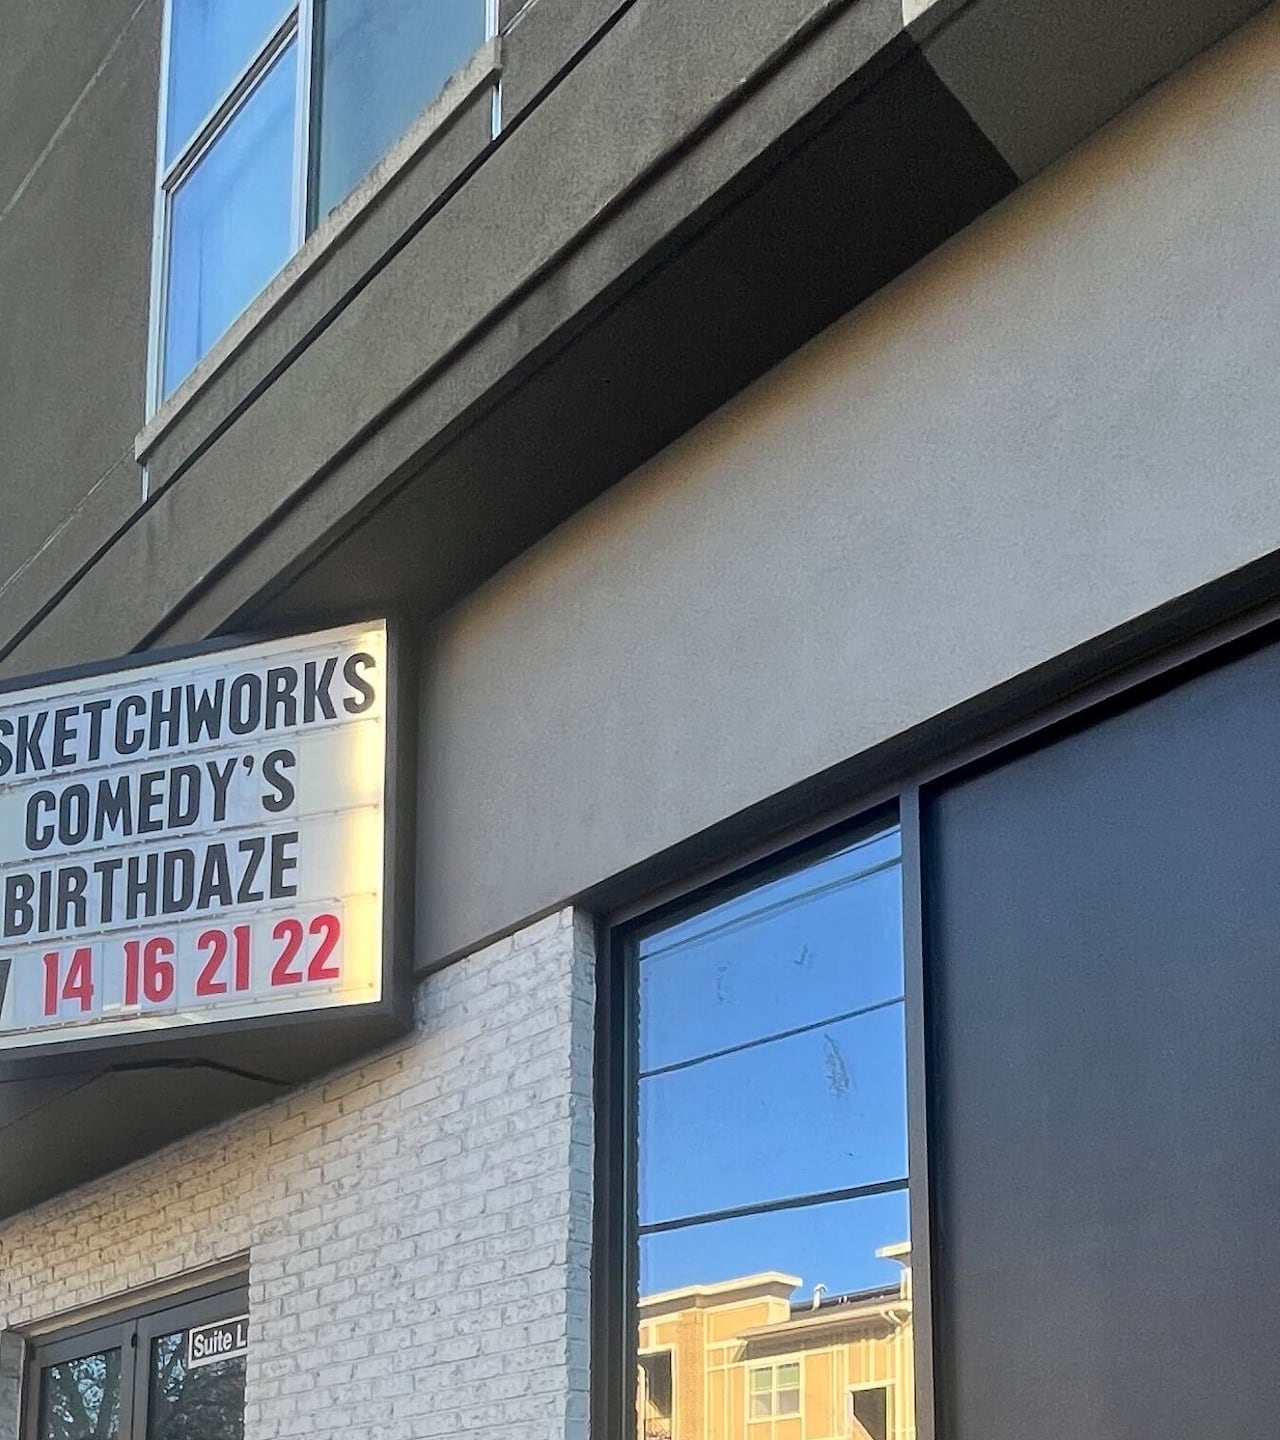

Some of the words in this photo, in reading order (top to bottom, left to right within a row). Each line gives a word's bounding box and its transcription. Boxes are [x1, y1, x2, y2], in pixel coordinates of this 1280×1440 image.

[25, 749, 297, 851] COMEDY'S
[3, 831, 300, 938] BIRTHDAZE
[43, 947, 95, 1017] 14
[123, 936, 175, 1006] 16
[196, 924, 251, 997] 21
[270, 913, 341, 987] 22
[193, 1330, 232, 1358] Suite
